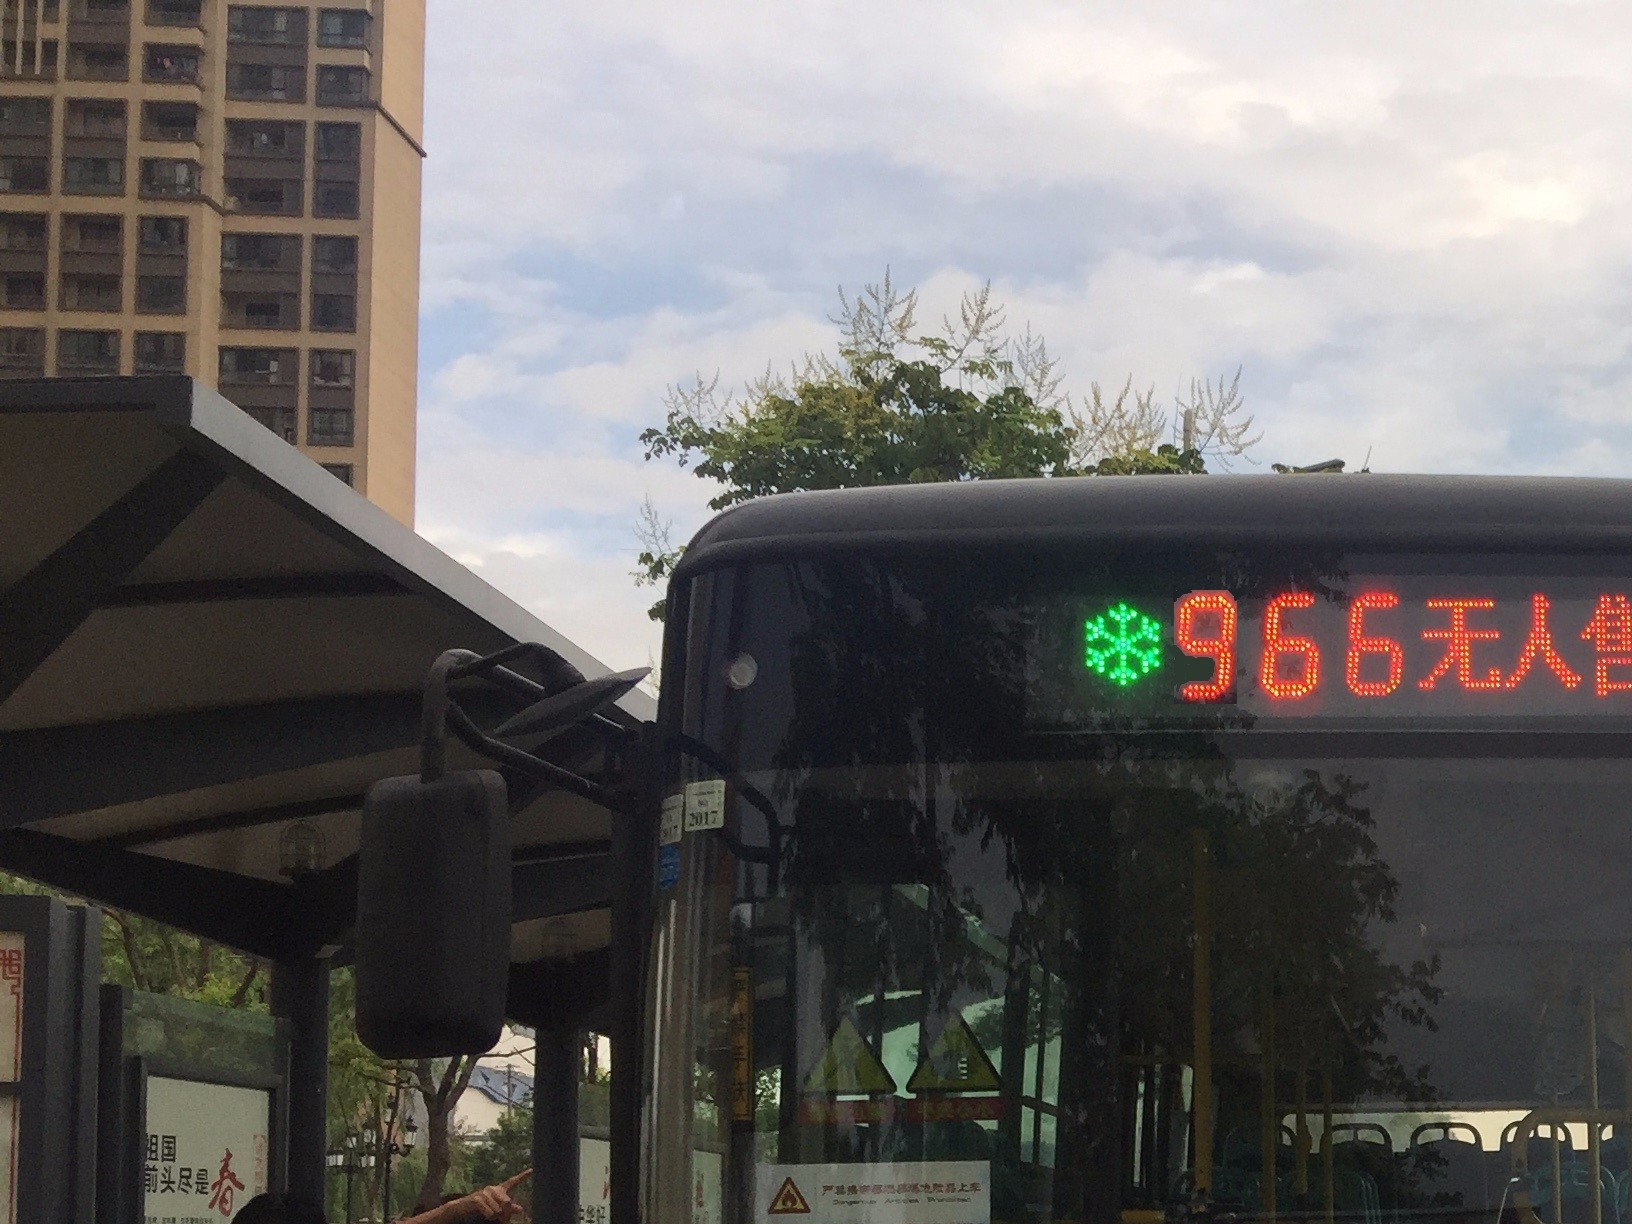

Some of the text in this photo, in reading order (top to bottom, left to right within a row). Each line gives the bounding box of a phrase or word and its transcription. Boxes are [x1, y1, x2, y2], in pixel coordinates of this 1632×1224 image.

[1178, 593, 1403, 698] 966
[689, 810, 718, 827] 2017
[208, 1147, 245, 1217] 春
